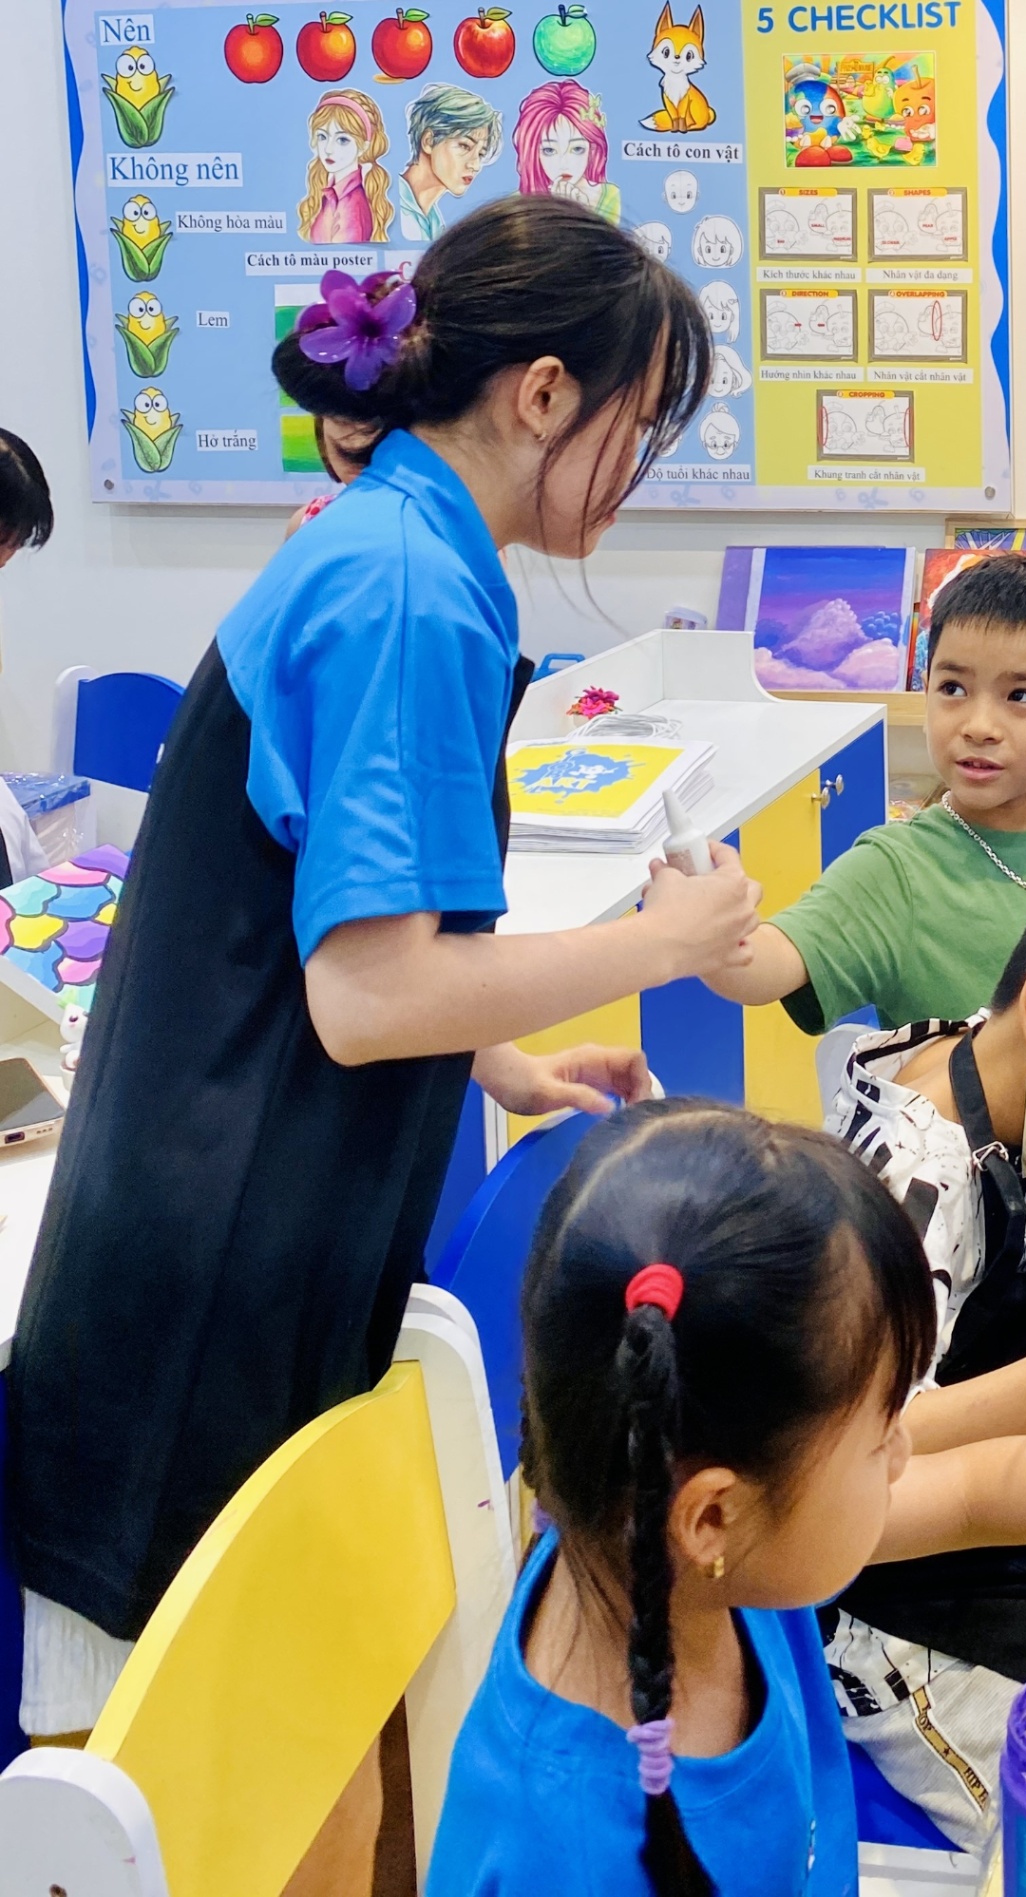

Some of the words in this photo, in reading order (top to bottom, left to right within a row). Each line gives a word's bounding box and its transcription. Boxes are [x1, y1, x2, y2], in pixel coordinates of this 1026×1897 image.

[757, 7, 774, 33] 5
[788, 1, 961, 33] CHECKLIST
[101, 18, 151, 42] Nên
[624, 142, 661, 157] Cách
[667, 143, 680, 158] tô
[685, 148, 711, 159] con
[716, 145, 739, 163] vật
[110, 155, 189, 186] Không
[196, 156, 239, 180] nên
[177, 214, 222, 232] Không
[226, 214, 250, 229] hòa
[254, 215, 283, 229] màu
[247, 253, 280, 267] Cách
[284, 254, 296, 266] tô
[301, 254, 328, 266] màu
[332, 255, 373, 269] poster
[763, 269, 784, 280] Kích
[786, 269, 809, 280] thước
[812, 270, 832, 280] khác
[834, 270, 855, 280] nhau
[883, 270, 906, 280] Nhân
[908, 271, 923, 282] vật
[937, 271, 958, 282] dạng
[896, 290, 945, 298] OVERLAPPING
[198, 312, 228, 327] Lem
[761, 369, 790, 380] Hướng
[814, 370, 834, 380] khác
[836, 371, 856, 380] nhau
[874, 370, 897, 380] Nhân
[899, 370, 913, 382] vật
[930, 371, 950, 381] nhân
[952, 371, 966, 382] vật
[198, 433, 218, 448] Hở
[222, 429, 257, 451] trắng
[647, 468, 663, 482] Độ
[667, 465, 688, 480] tuổi
[692, 468, 719, 480] khác
[722, 468, 750, 480] nhau
[814, 470, 843, 481] Khung
[845, 471, 867, 480] tranh
[884, 471, 905, 481] nhân
[907, 471, 920, 482] vật
[964, 1766, 981, 1789] HIP
